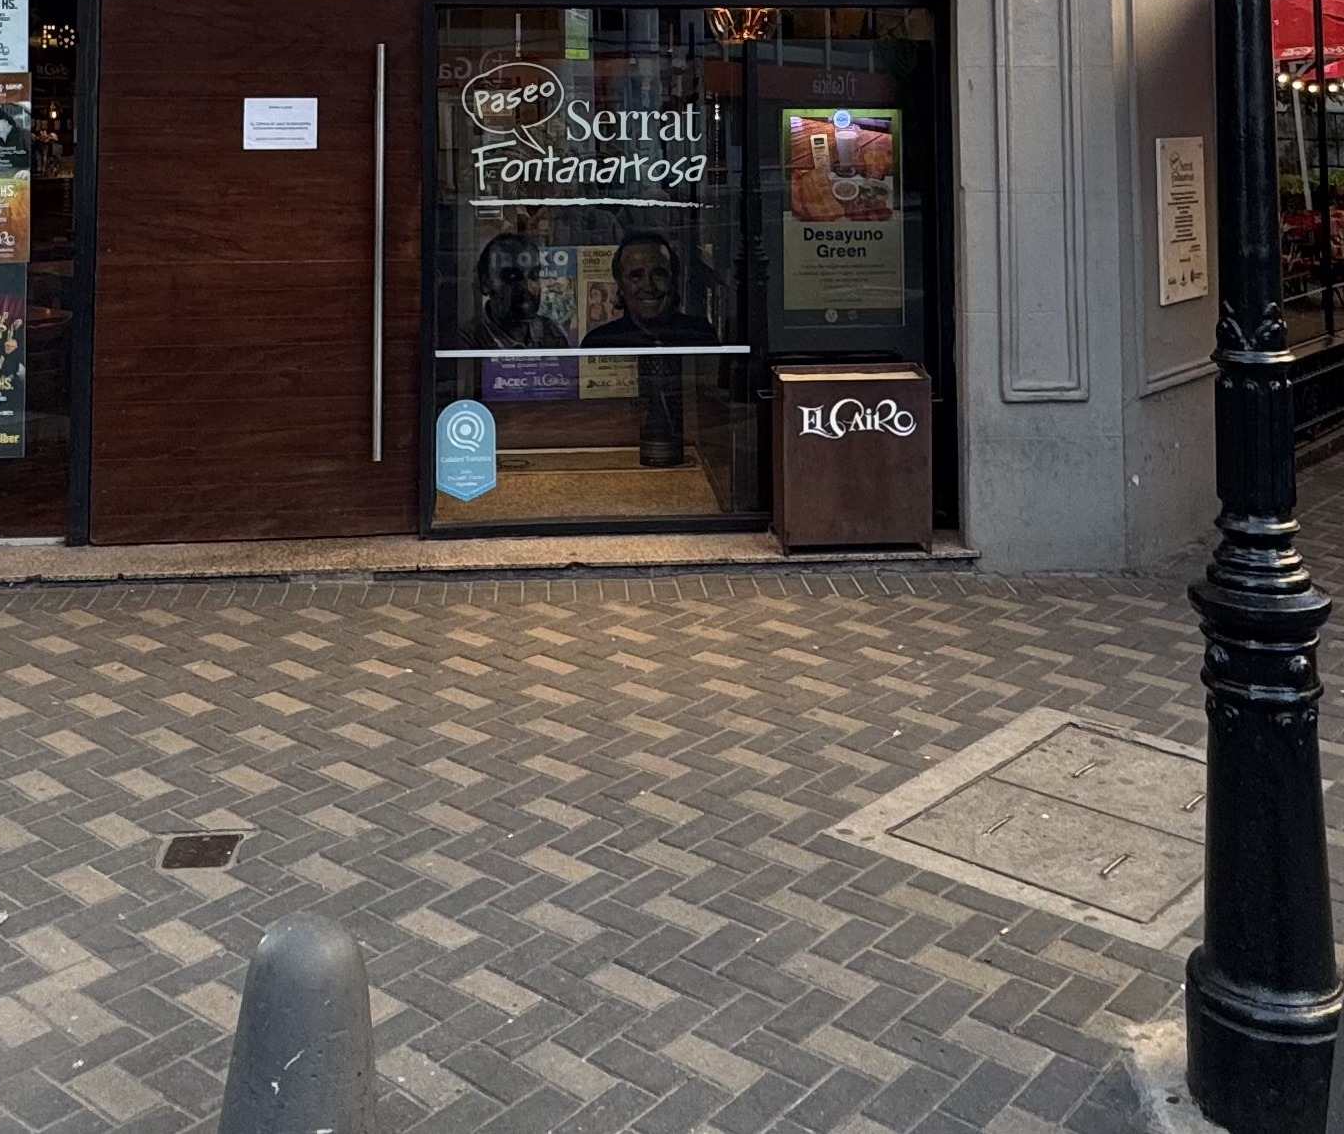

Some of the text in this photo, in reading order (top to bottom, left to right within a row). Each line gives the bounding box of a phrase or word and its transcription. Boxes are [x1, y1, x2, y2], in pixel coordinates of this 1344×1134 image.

[566, 99, 703, 142] Serrat
[471, 140, 708, 191] Fontanarrosa
[803, 228, 884, 244] Desayuno
[816, 244, 867, 258] Green
